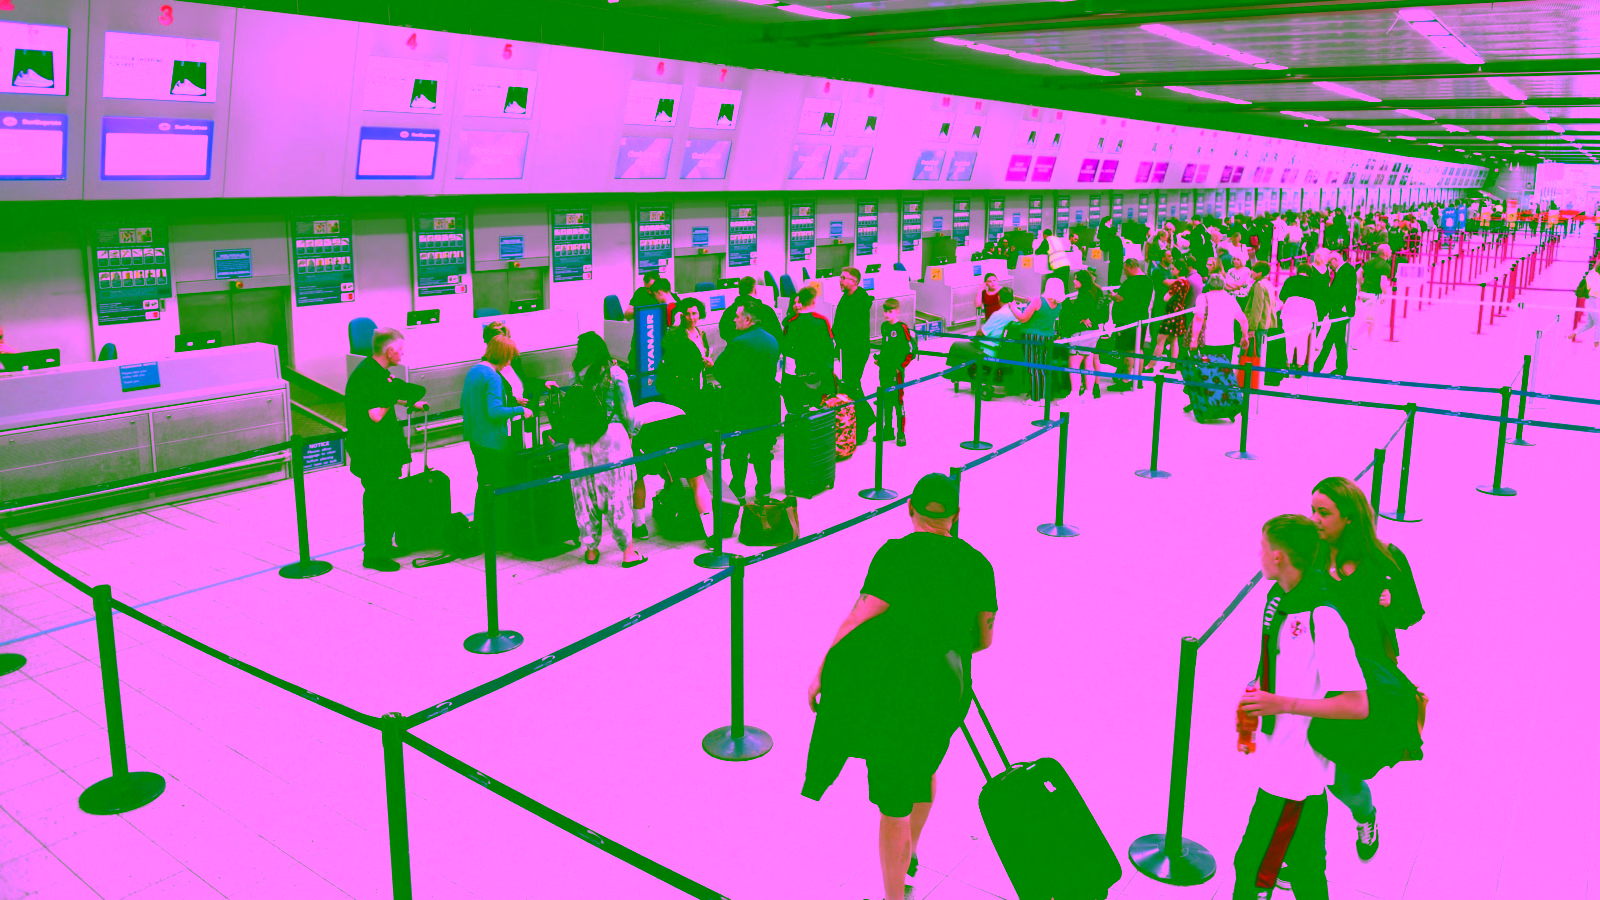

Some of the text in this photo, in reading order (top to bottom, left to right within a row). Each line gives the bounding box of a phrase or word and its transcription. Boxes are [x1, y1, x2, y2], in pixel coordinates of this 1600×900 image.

[159, 4, 174, 26] 3
[406, 33, 417, 50] 4
[502, 43, 513, 60] 5
[656, 61, 665, 76] 6
[719, 68, 728, 83] 7
[309, 441, 330, 449] NOTICE
